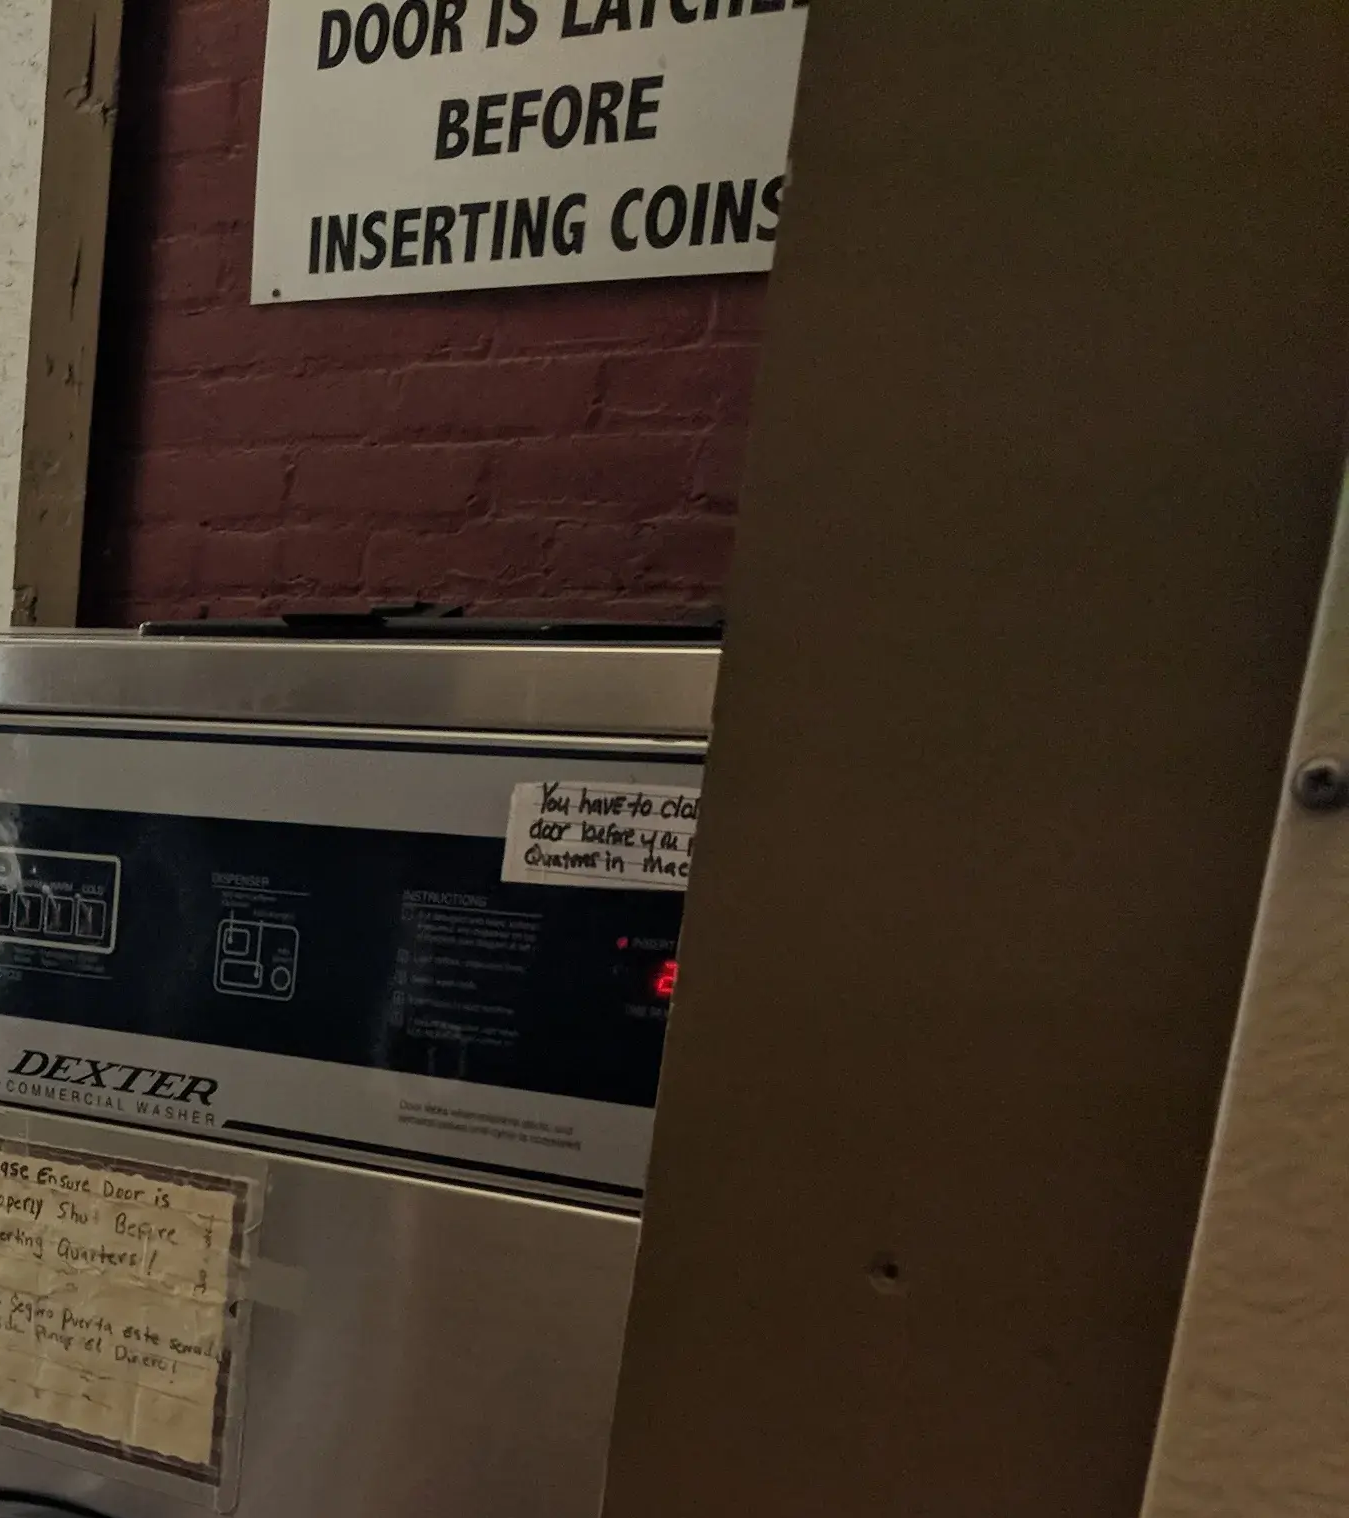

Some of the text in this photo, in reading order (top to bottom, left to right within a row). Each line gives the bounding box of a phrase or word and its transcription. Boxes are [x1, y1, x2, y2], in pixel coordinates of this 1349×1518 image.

[317, 0, 463, 70] DOOR
[486, 0, 539, 48] IS
[434, 74, 665, 161] BEFORE
[307, 174, 787, 274] INSERTING COINS
[541, 782, 570, 816] You
[627, 792, 653, 818] to
[529, 817, 570, 842] door
[605, 850, 624, 873] in
[402, 889, 490, 907] INSTRUCTIONS
[7, 1049, 218, 1107] DEXTER
[6, 1079, 215, 1127] COMMERCIAL WASHER
[37, 1166, 91, 1193] Ensure
[103, 1179, 145, 1201] Door
[154, 1187, 170, 1209] is
